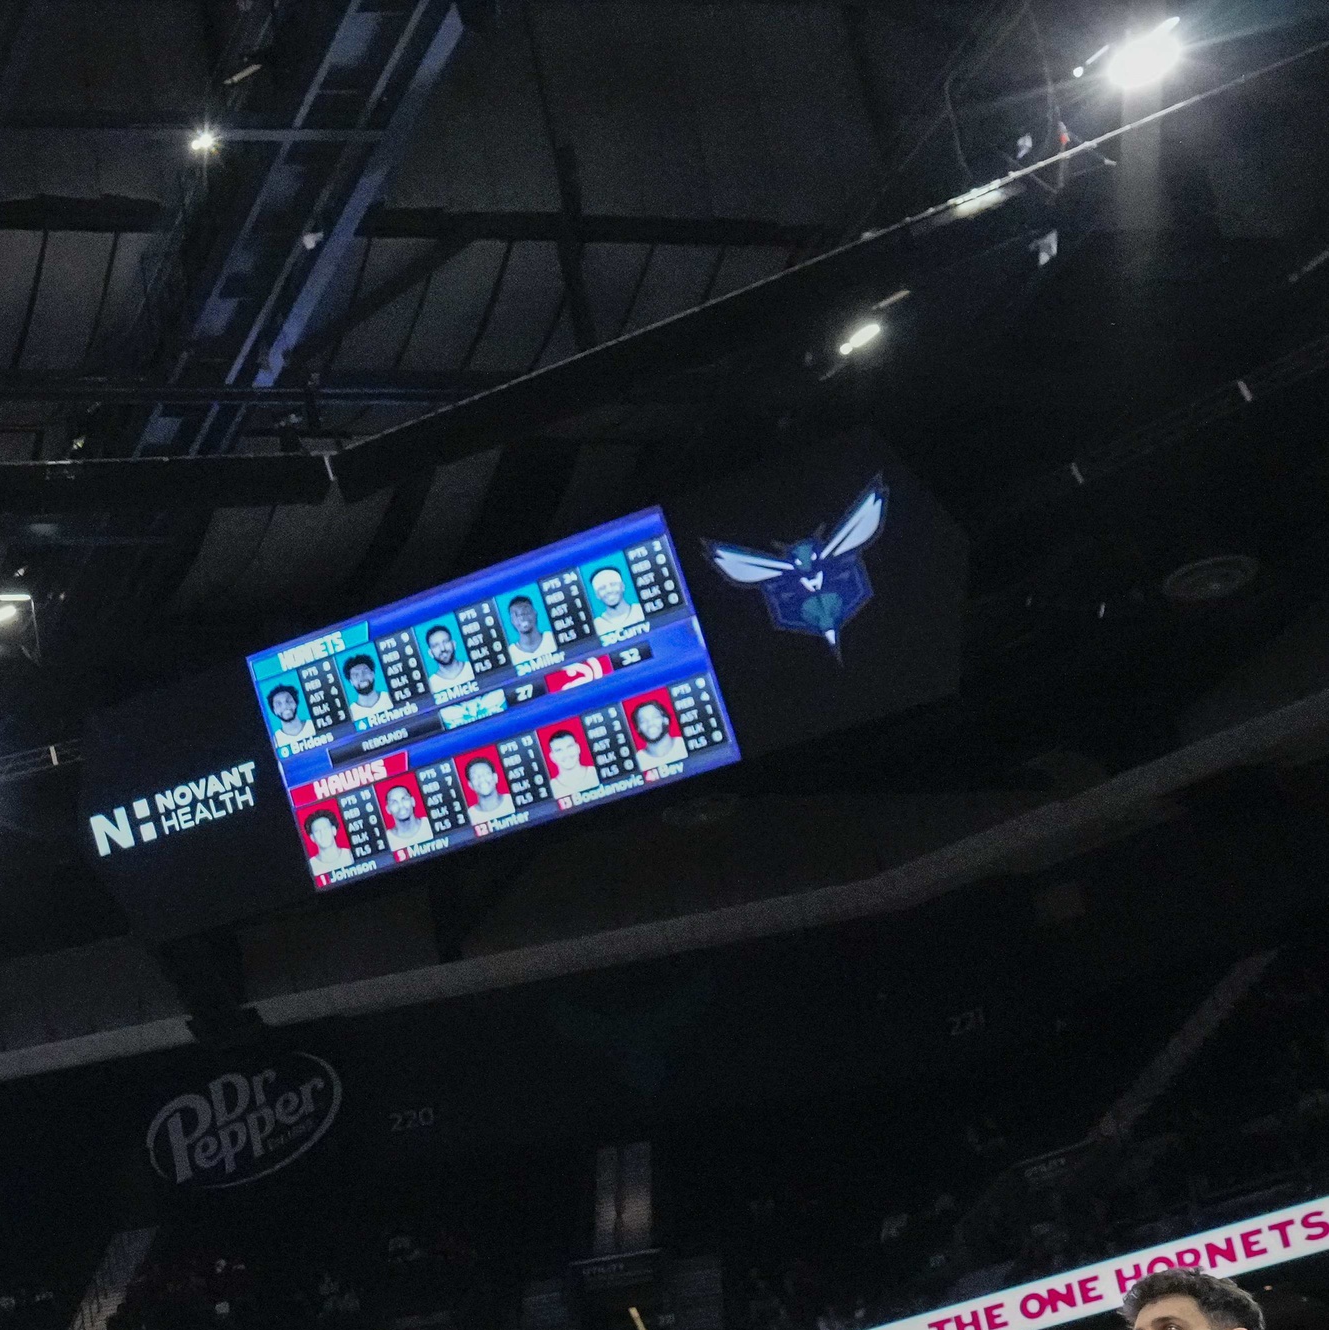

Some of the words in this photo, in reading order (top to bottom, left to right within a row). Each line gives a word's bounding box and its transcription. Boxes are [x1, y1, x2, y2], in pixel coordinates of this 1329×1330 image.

[529, 652, 566, 671] Miller
[619, 648, 641, 667] 32
[447, 680, 480, 700] Micic
[515, 684, 534, 700] 27
[367, 702, 419, 727] Richards
[362, 728, 409, 751] REBOUNDS
[154, 761, 255, 814] NOVANT
[313, 759, 387, 800] HAWKS
[160, 786, 255, 835] HEALTH
[488, 810, 530, 833] Hunter
[407, 836, 449, 858] Murray
[329, 859, 377, 884] Johnson
[208, 1069, 277, 1126] Dr
[147, 1076, 324, 1184] Pepper
[390, 1108, 435, 1131] 220
[1020, 1275, 1103, 1320] ONE
